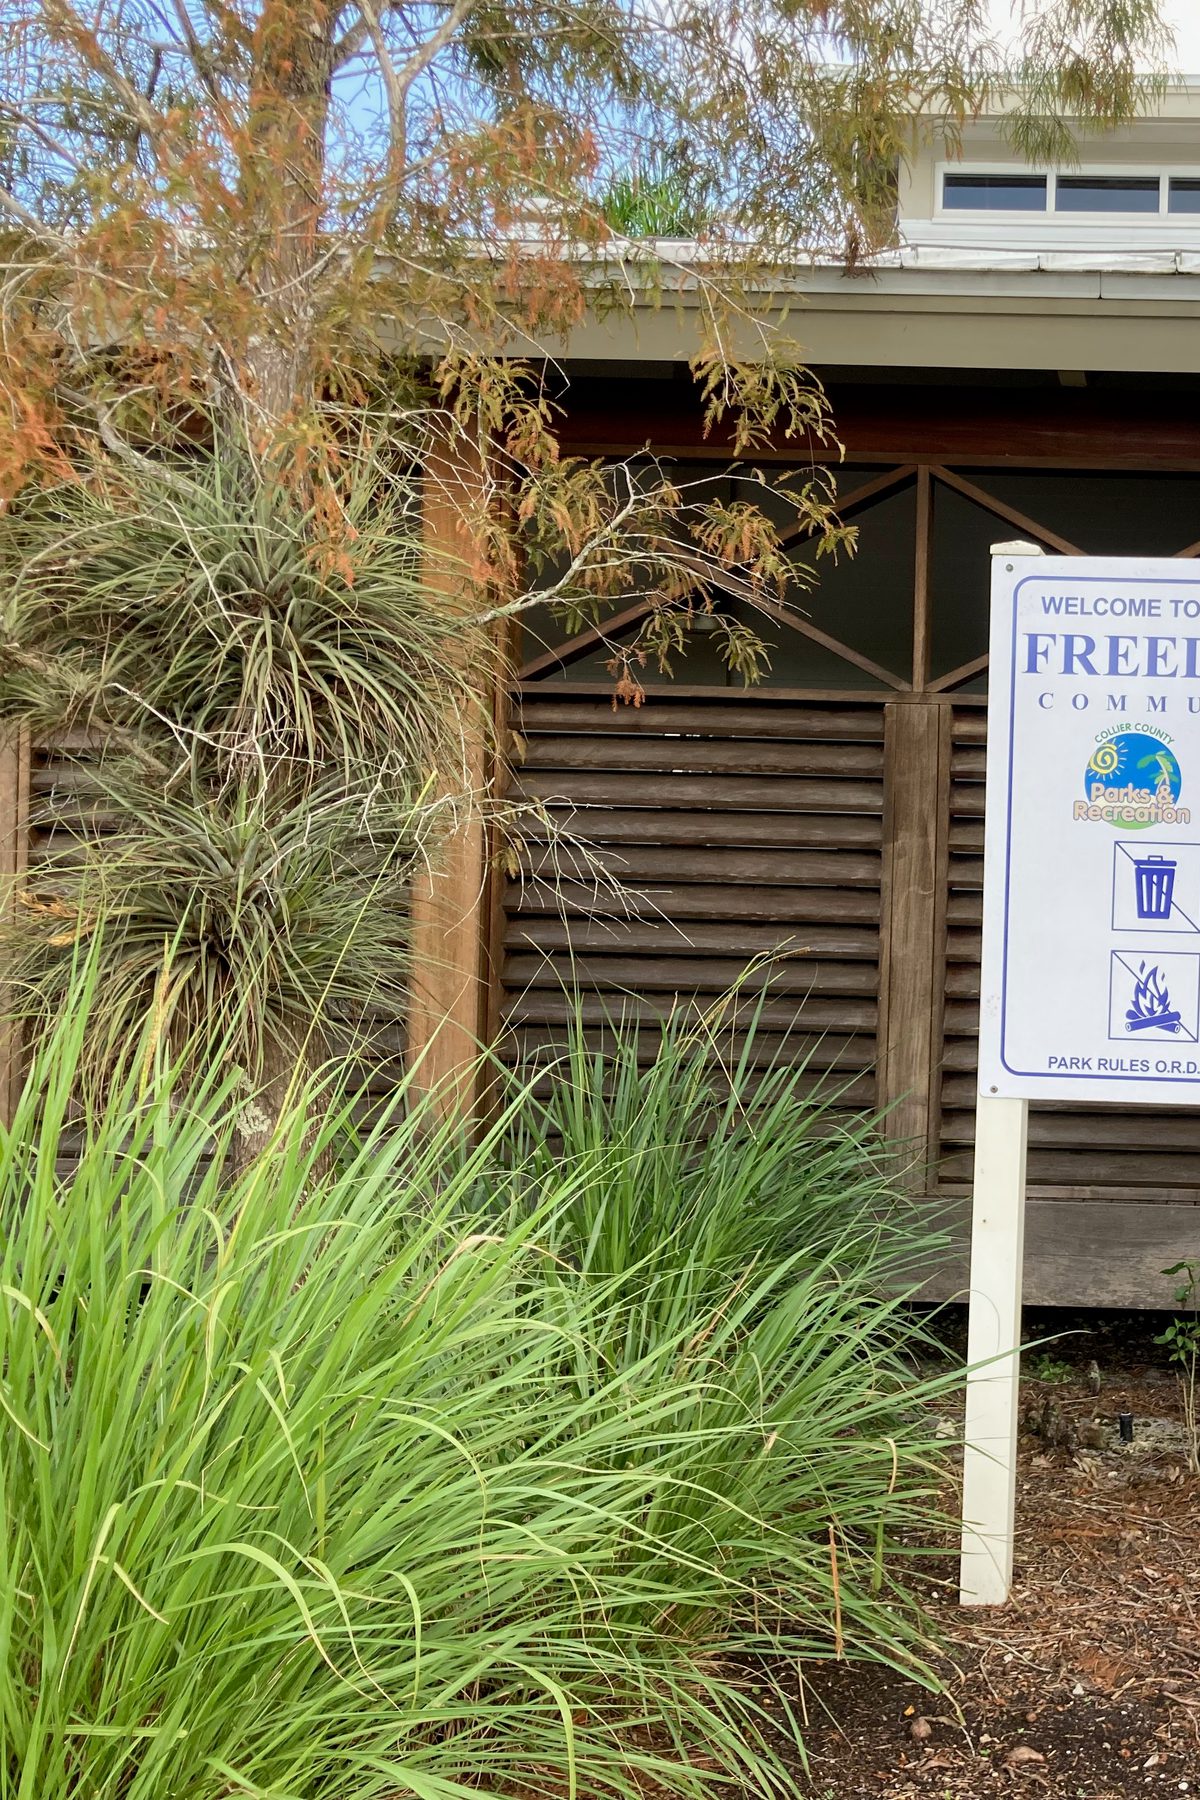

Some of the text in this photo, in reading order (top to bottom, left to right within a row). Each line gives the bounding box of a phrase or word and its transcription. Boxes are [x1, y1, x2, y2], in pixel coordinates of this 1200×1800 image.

[1041, 596, 1162, 618] WELCOME
[1169, 599, 1200, 619] TO
[1094, 723, 1175, 745] COLLIER COUNTY
[1090, 782, 1175, 804] Parks &
[1073, 800, 1191, 825] Recreation
[1047, 1056, 1092, 1070] PARK
[1097, 1057, 1150, 1073] RULES
